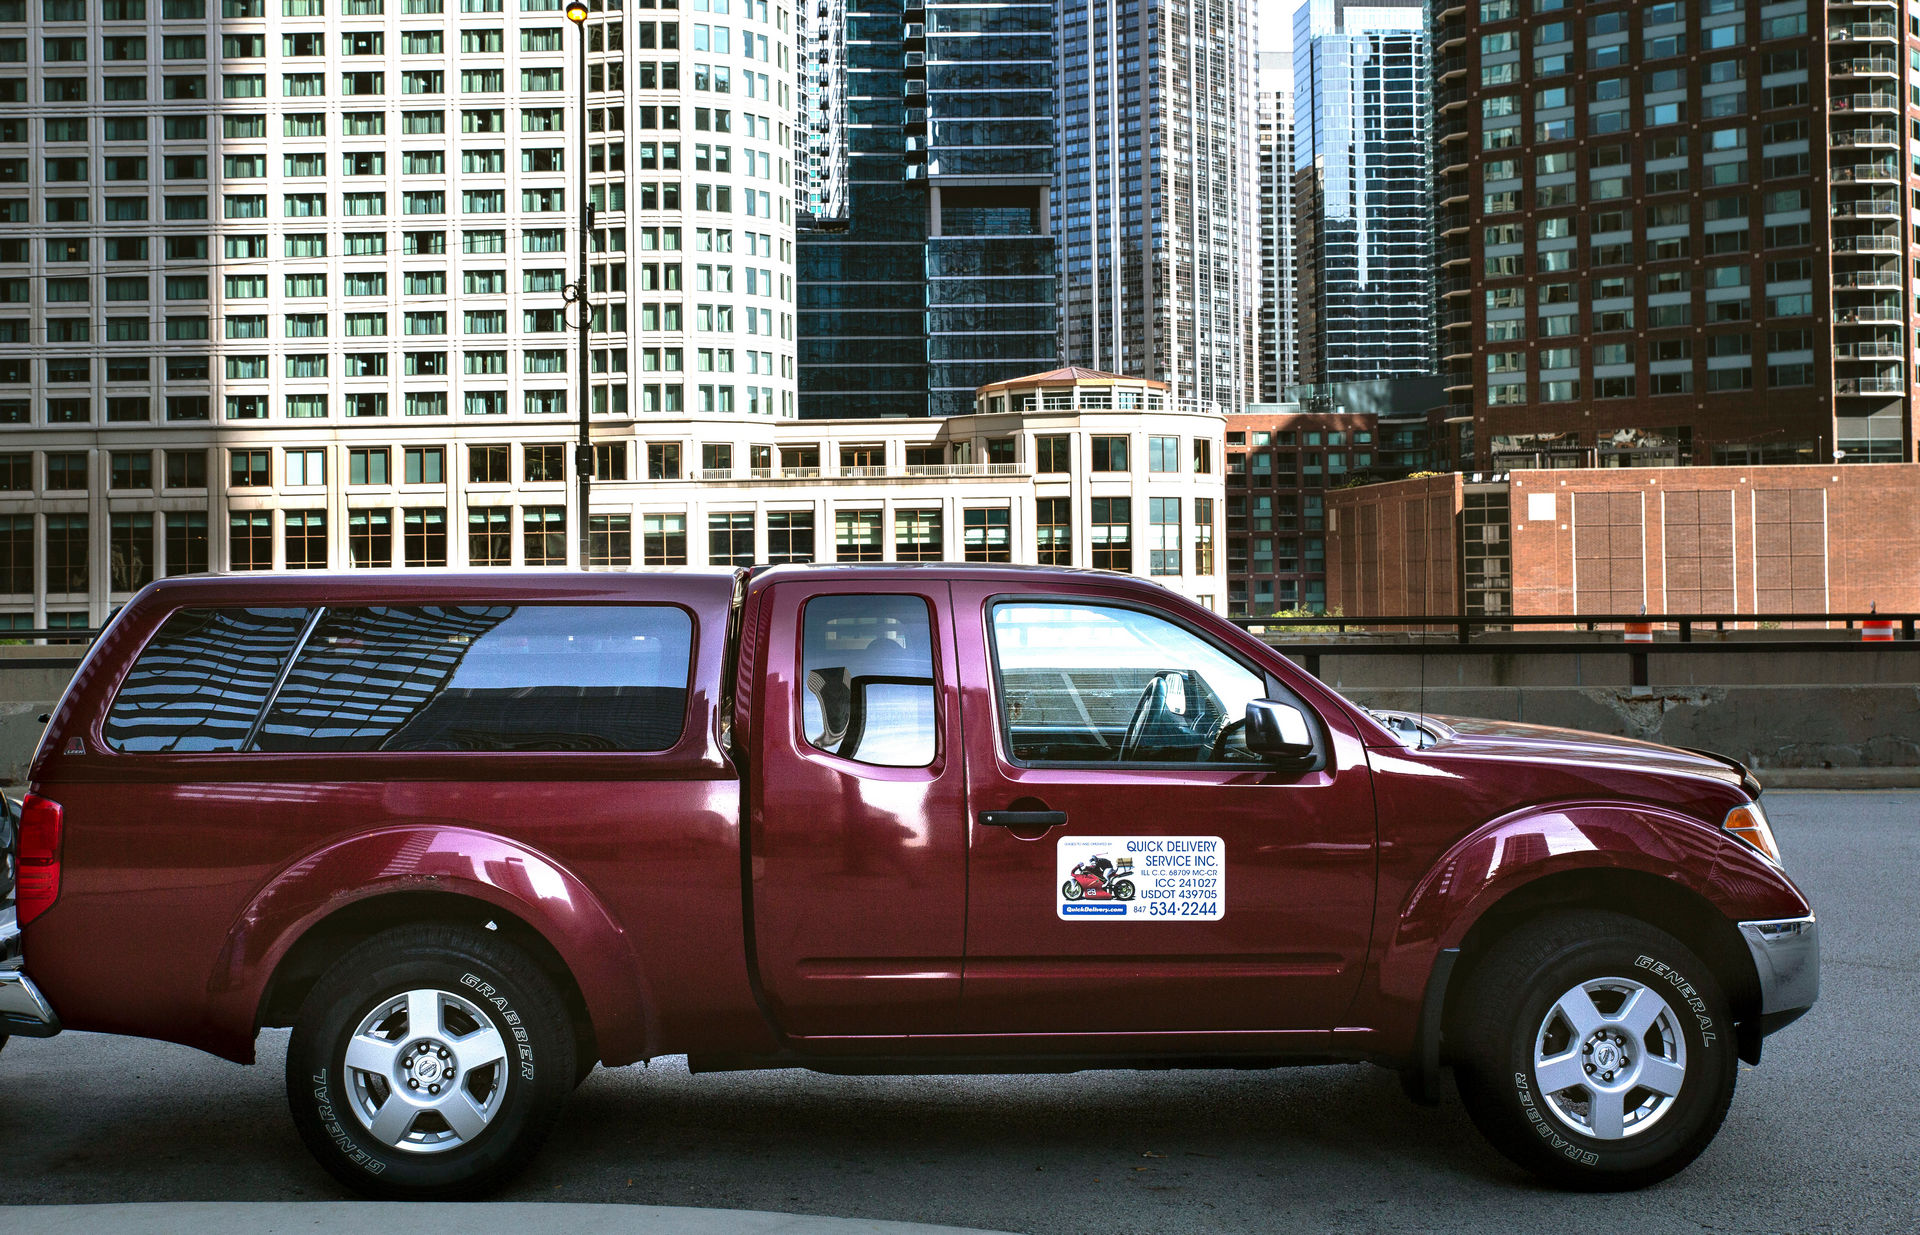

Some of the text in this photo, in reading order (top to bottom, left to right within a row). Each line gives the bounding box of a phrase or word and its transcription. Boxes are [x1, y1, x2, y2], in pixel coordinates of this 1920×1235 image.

[1126, 841, 1217, 852] QUICK DELIVERY
[1145, 855, 1218, 867] SERVICE INC.
[1155, 878, 1217, 888] ICC 241027
[1141, 889, 1218, 899] USDOT 439705
[1066, 906, 1124, 914] QuickDelivery.com
[1133, 905, 1147, 913] 847
[1634, 954, 1716, 1048] GENERAL
[460, 972, 534, 1081] GRABBER
[313, 1068, 386, 1175] GENERAL
[1514, 1072, 1599, 1166] GRABBER
